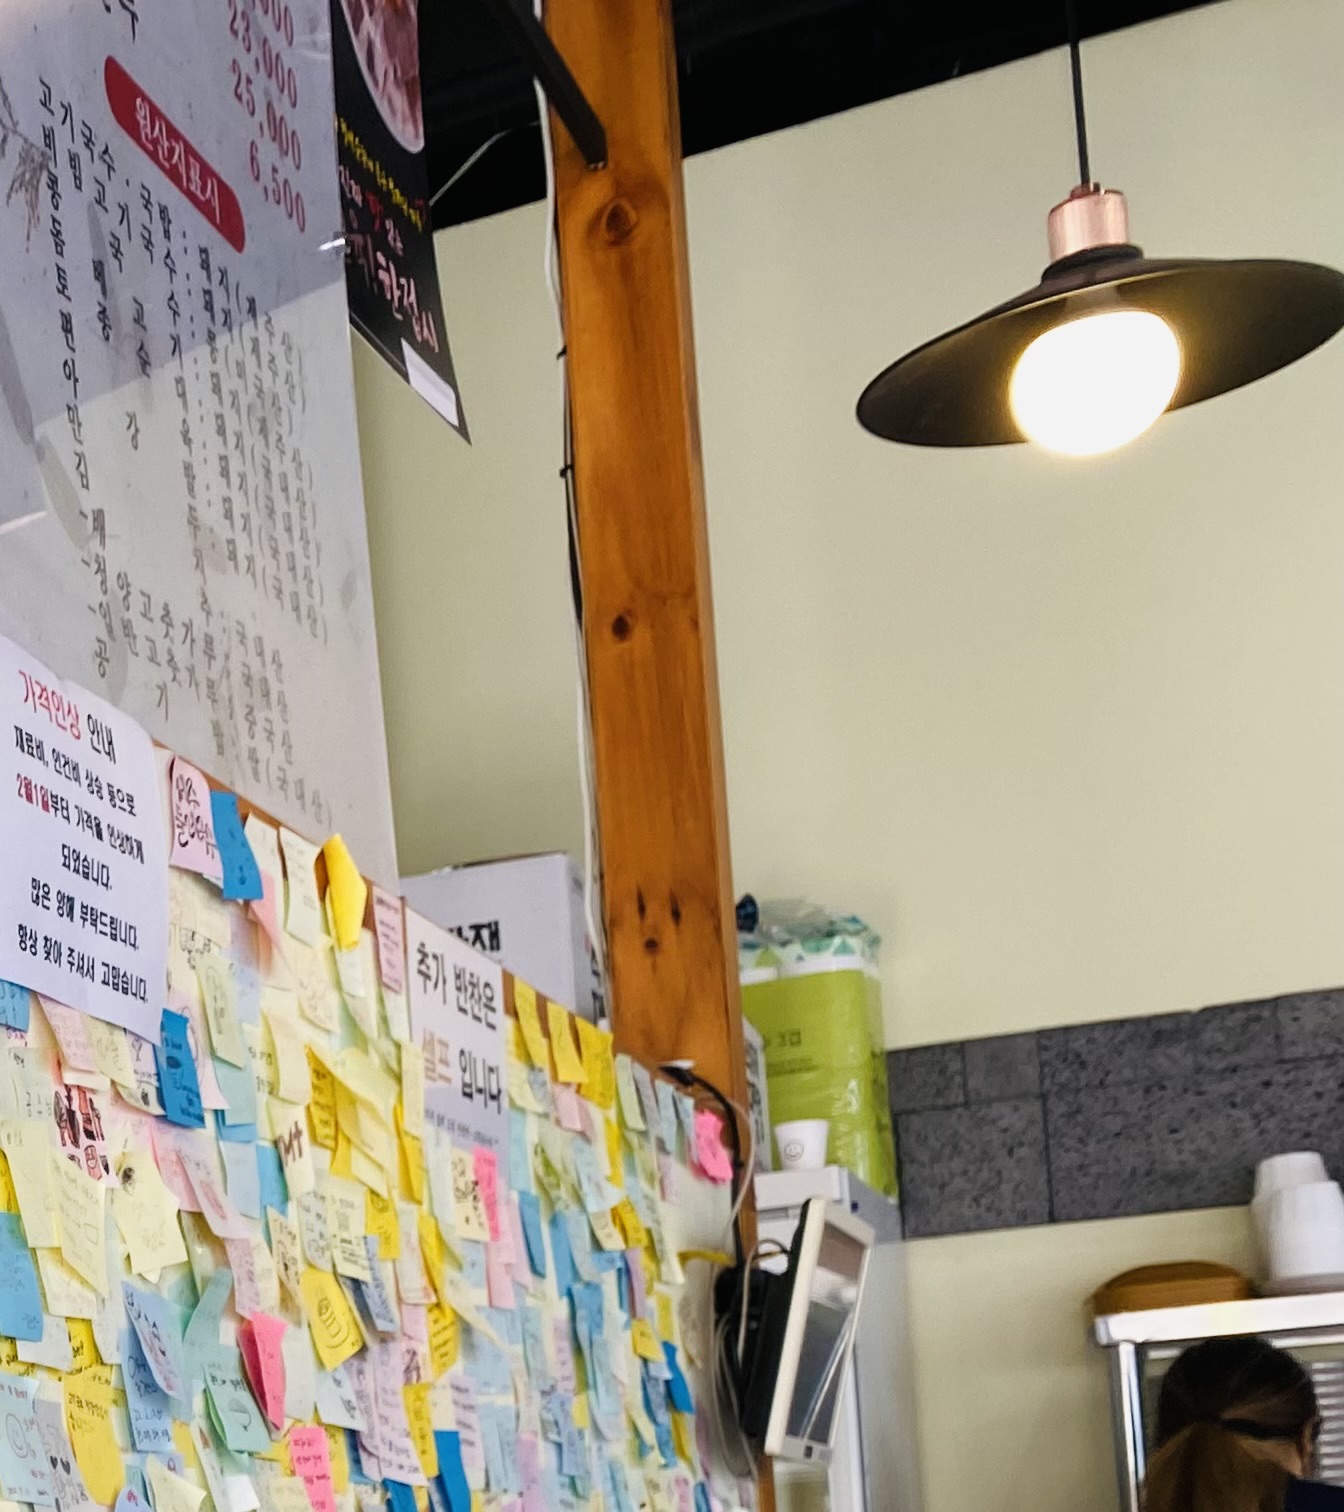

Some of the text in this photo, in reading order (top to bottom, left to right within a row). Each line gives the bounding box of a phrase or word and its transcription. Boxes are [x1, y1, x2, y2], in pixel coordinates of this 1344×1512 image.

[233, 58, 301, 170] 25,000
[135, 97, 220, 222] 원산지표시
[250, 140, 305, 234] 6,500
[19, 670, 117, 764] 가격인상 안내
[14, 725, 137, 817] 재료비, 인건비 상승 등으로
[61, 843, 112, 890] 되었습니다.
[75, 804, 104, 842] 가격을
[107, 823, 145, 864] 인상하게
[31, 877, 139, 950] 많은 양해 부탁드립니다.
[18, 924, 148, 1003] 항상 찾아 주셔서 고맙습니다.
[417, 942, 497, 1031] 추가 반찬은
[423, 1028, 502, 1115] 셀프 입니다
